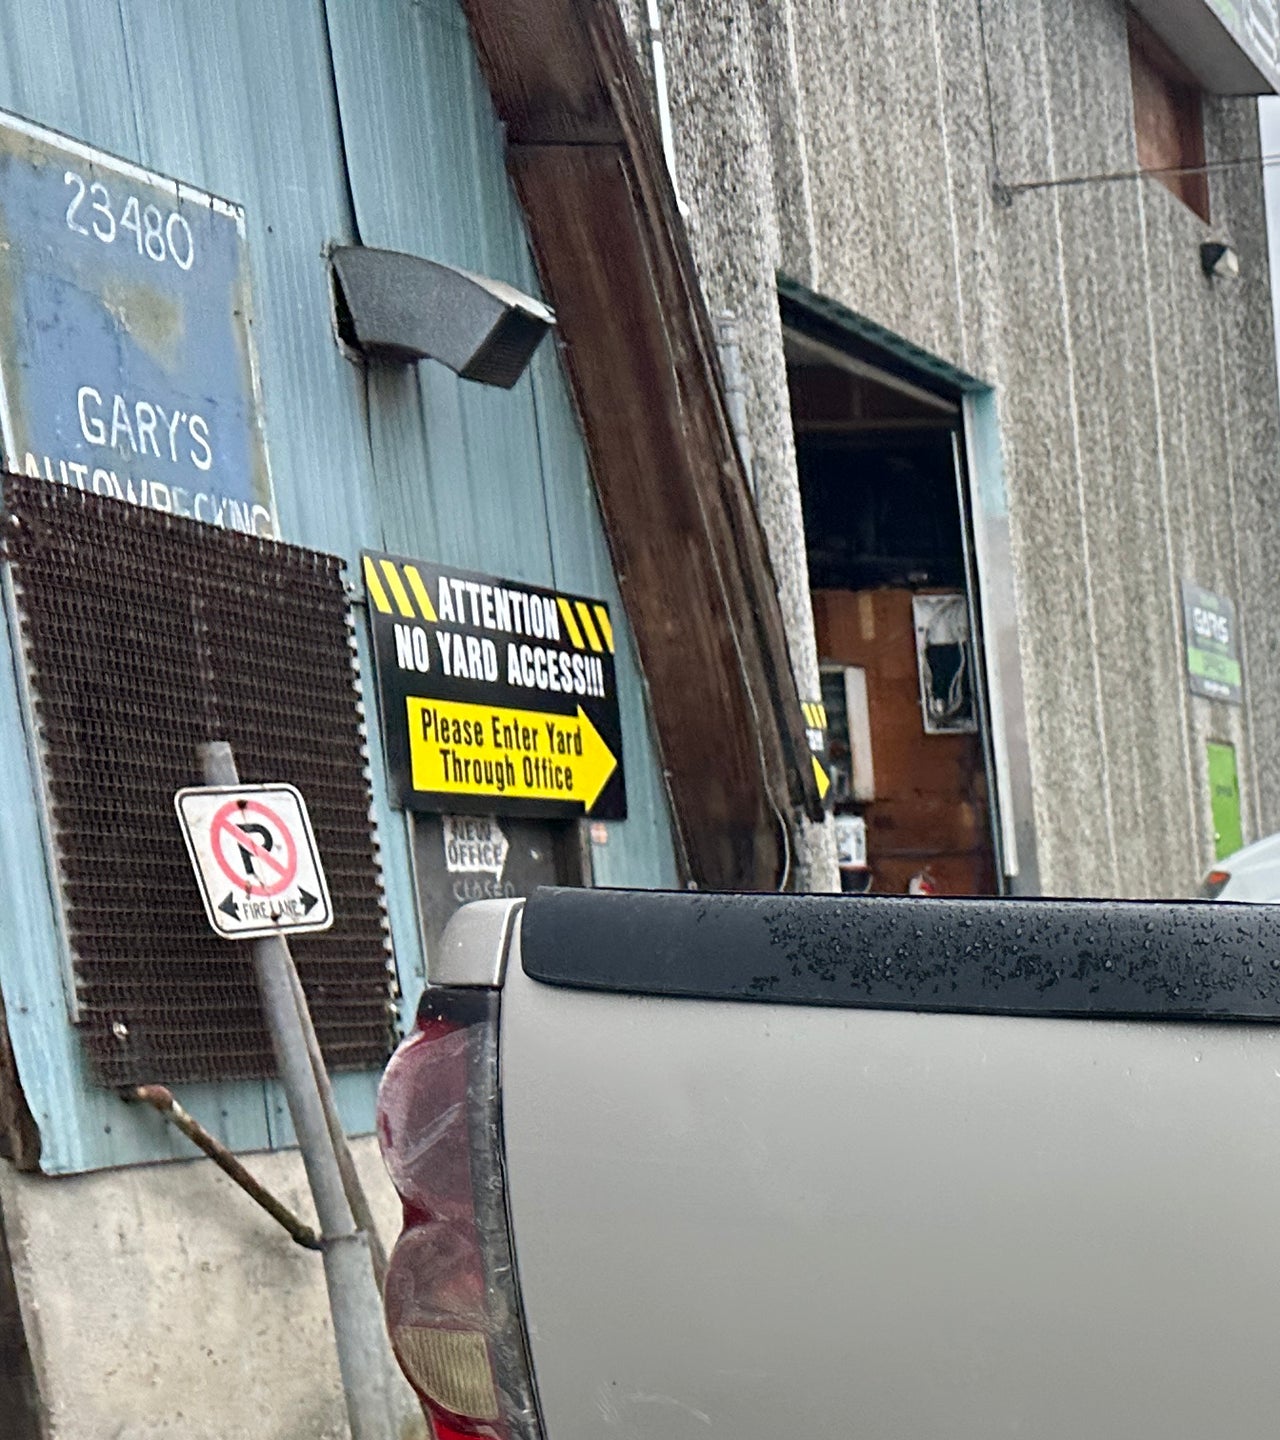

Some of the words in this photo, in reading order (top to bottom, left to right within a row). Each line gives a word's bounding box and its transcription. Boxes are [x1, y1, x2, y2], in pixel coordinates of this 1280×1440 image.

[63, 170, 195, 271] 23480
[77, 386, 213, 471] GARY'S
[437, 576, 561, 641] ATTENTION
[394, 623, 430, 672] NO
[436, 630, 499, 682] YARD
[507, 642, 605, 697] ACCESS!!!
[421, 707, 484, 747] Please
[491, 715, 538, 752] Enter
[546, 721, 583, 756] Yard
[439, 748, 515, 792] Through
[522, 756, 573, 791] Office
[448, 841, 503, 867] OFFICE
[242, 902, 267, 920] FIRE
